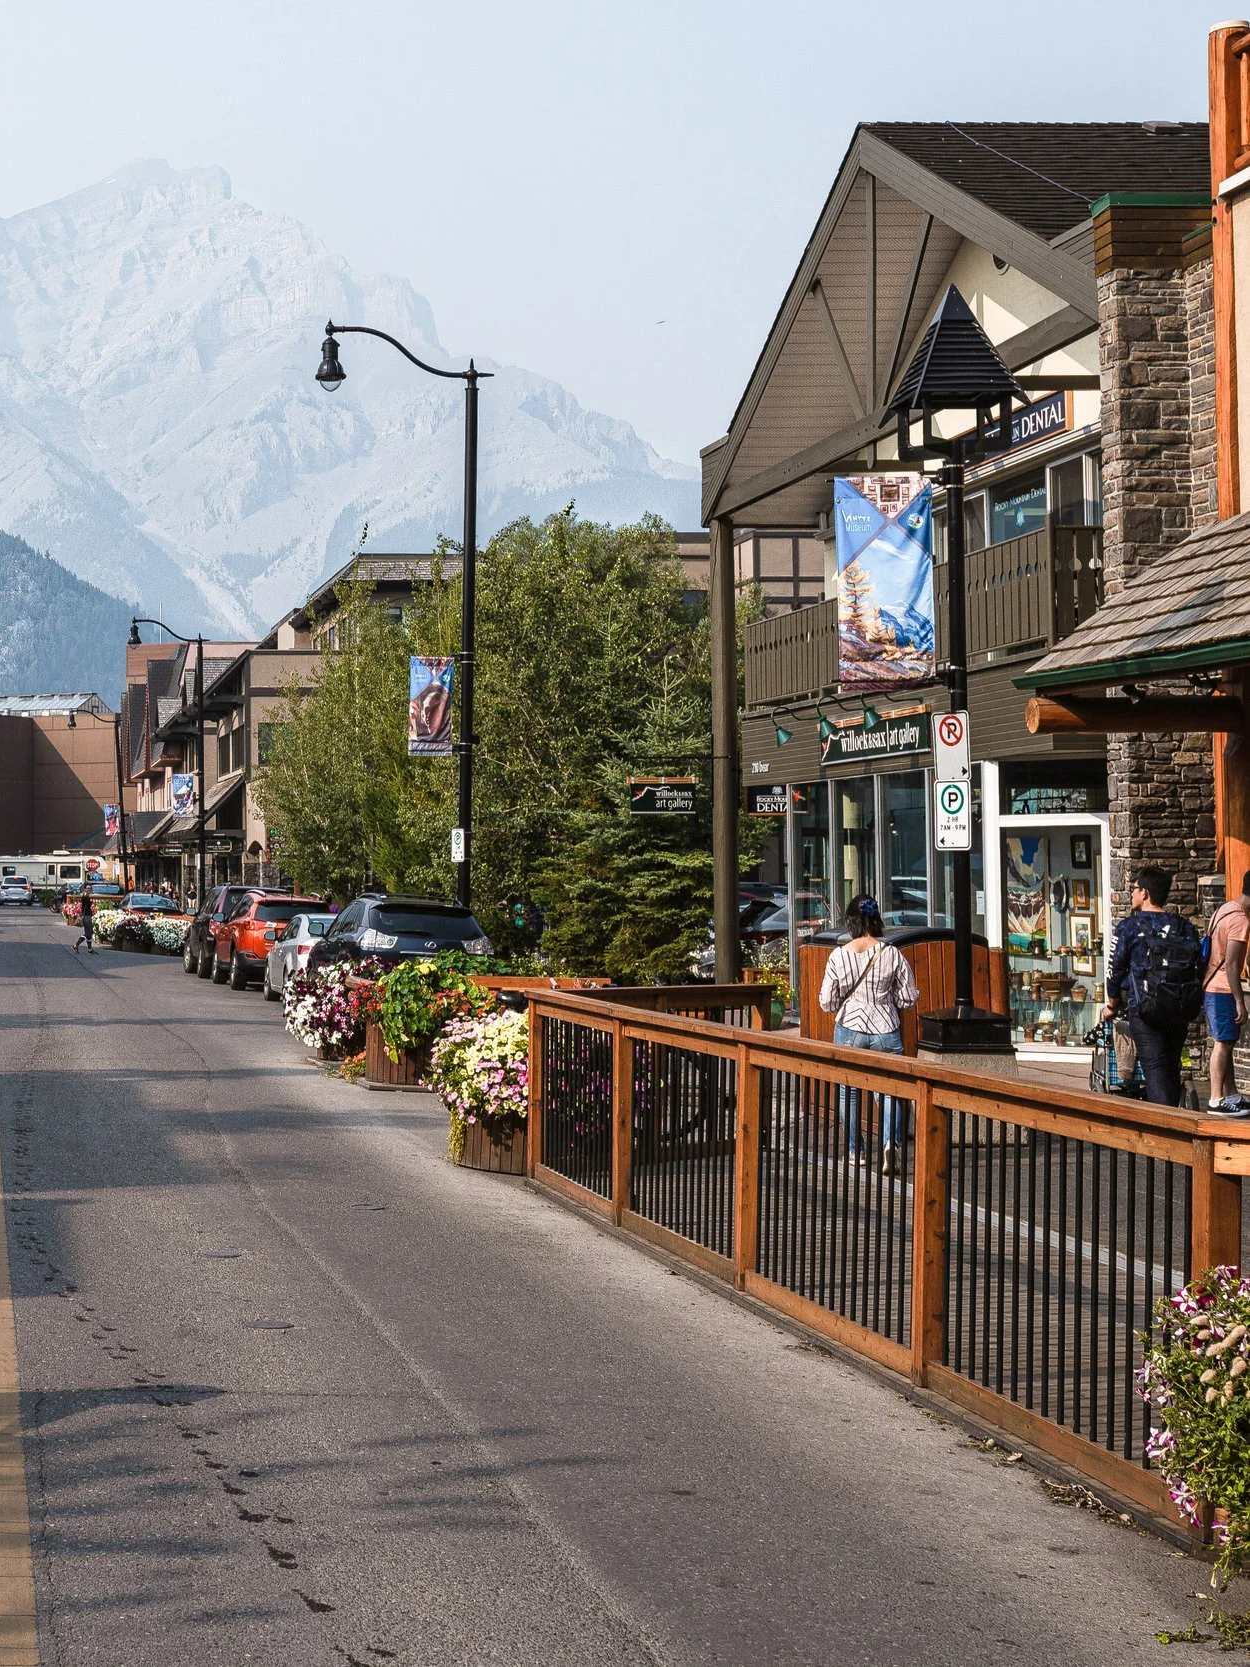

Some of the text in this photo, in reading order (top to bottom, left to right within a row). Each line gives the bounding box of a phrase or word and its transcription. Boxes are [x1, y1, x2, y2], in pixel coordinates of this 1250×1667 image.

[1021, 401, 1066, 439] DENTAL
[841, 509, 871, 522] WHYTE
[889, 727, 898, 746] art
[898, 722, 920, 750] gallery
[655, 798, 693, 811] art gallery
[948, 792, 958, 808] P
